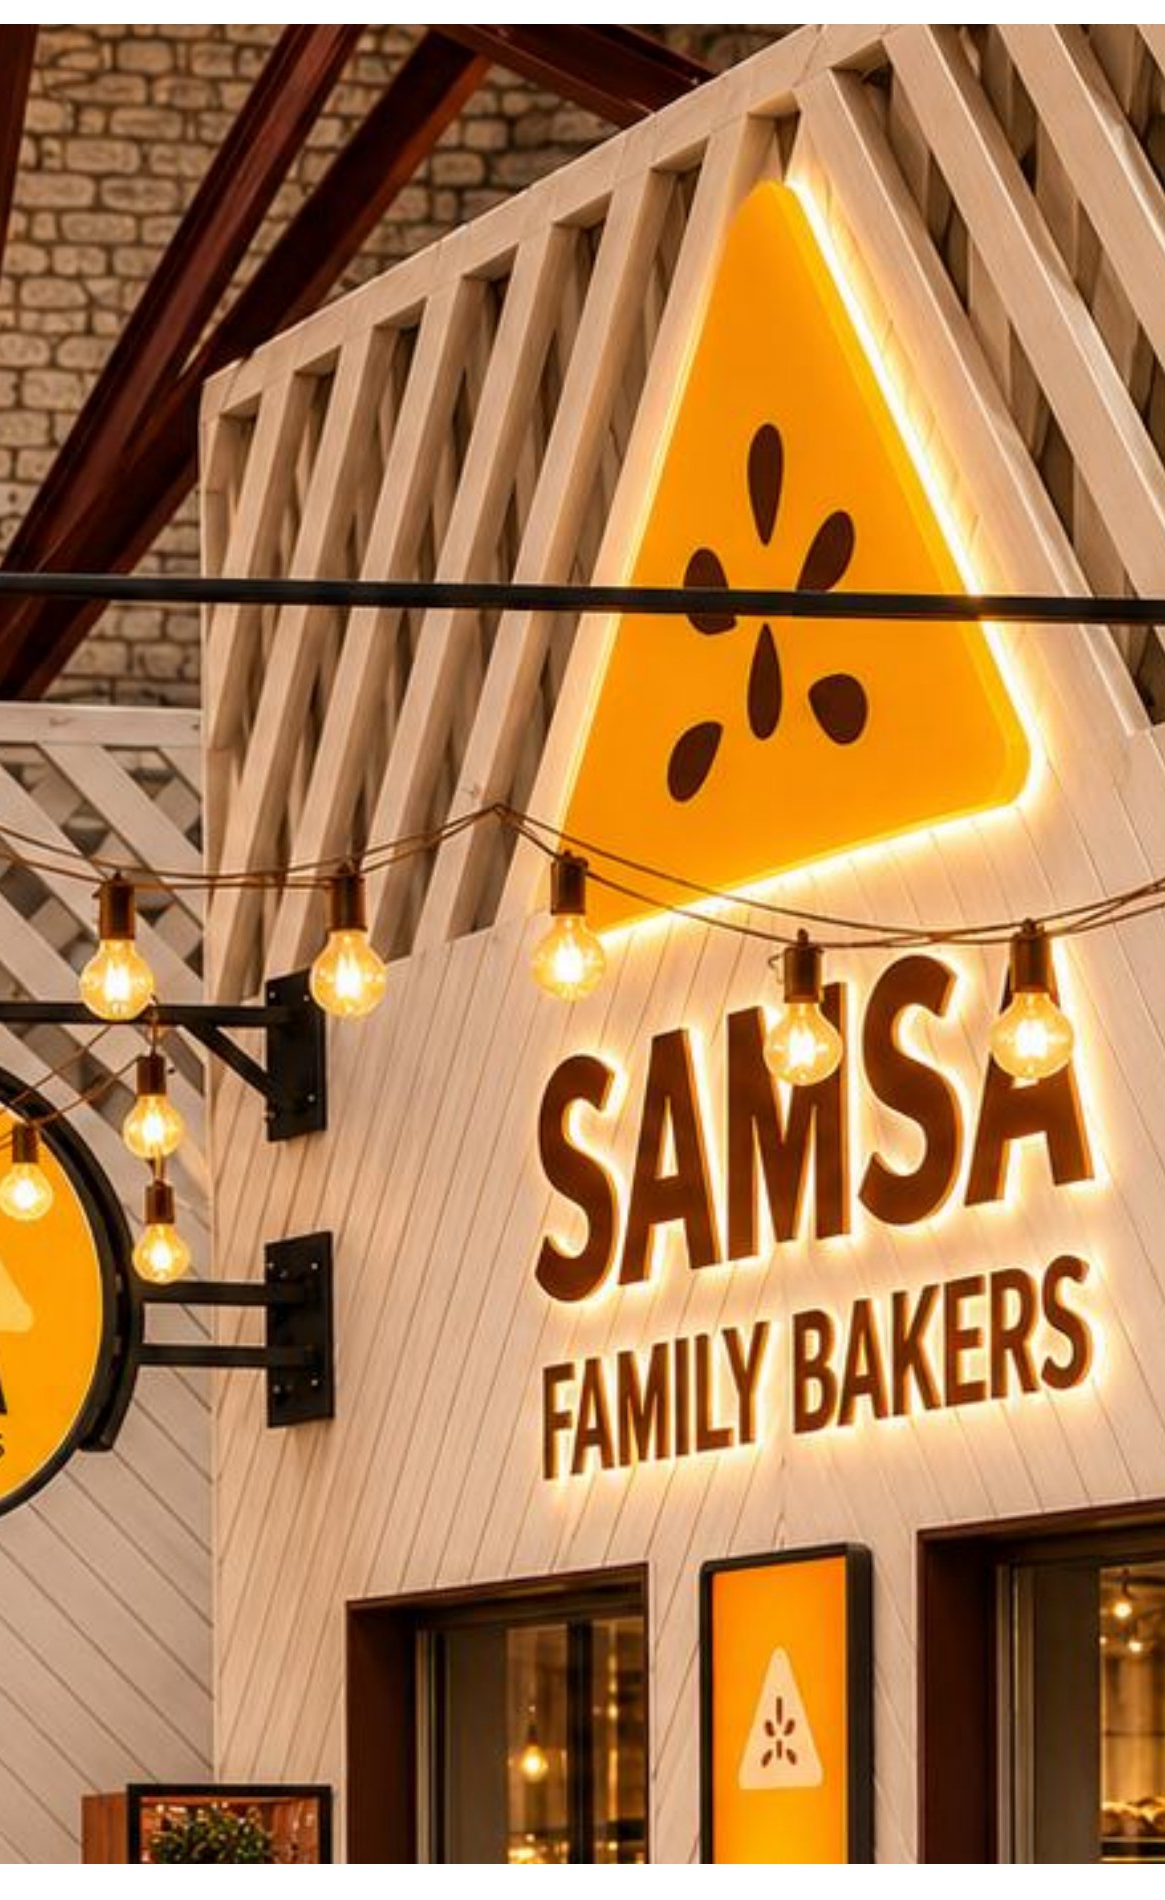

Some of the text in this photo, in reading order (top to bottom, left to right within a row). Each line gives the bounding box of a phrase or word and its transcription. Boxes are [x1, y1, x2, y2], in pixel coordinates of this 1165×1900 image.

[535, 948, 1095, 1303] SAMSA
[542, 1255, 1094, 1480] FAMILY BAKERS
